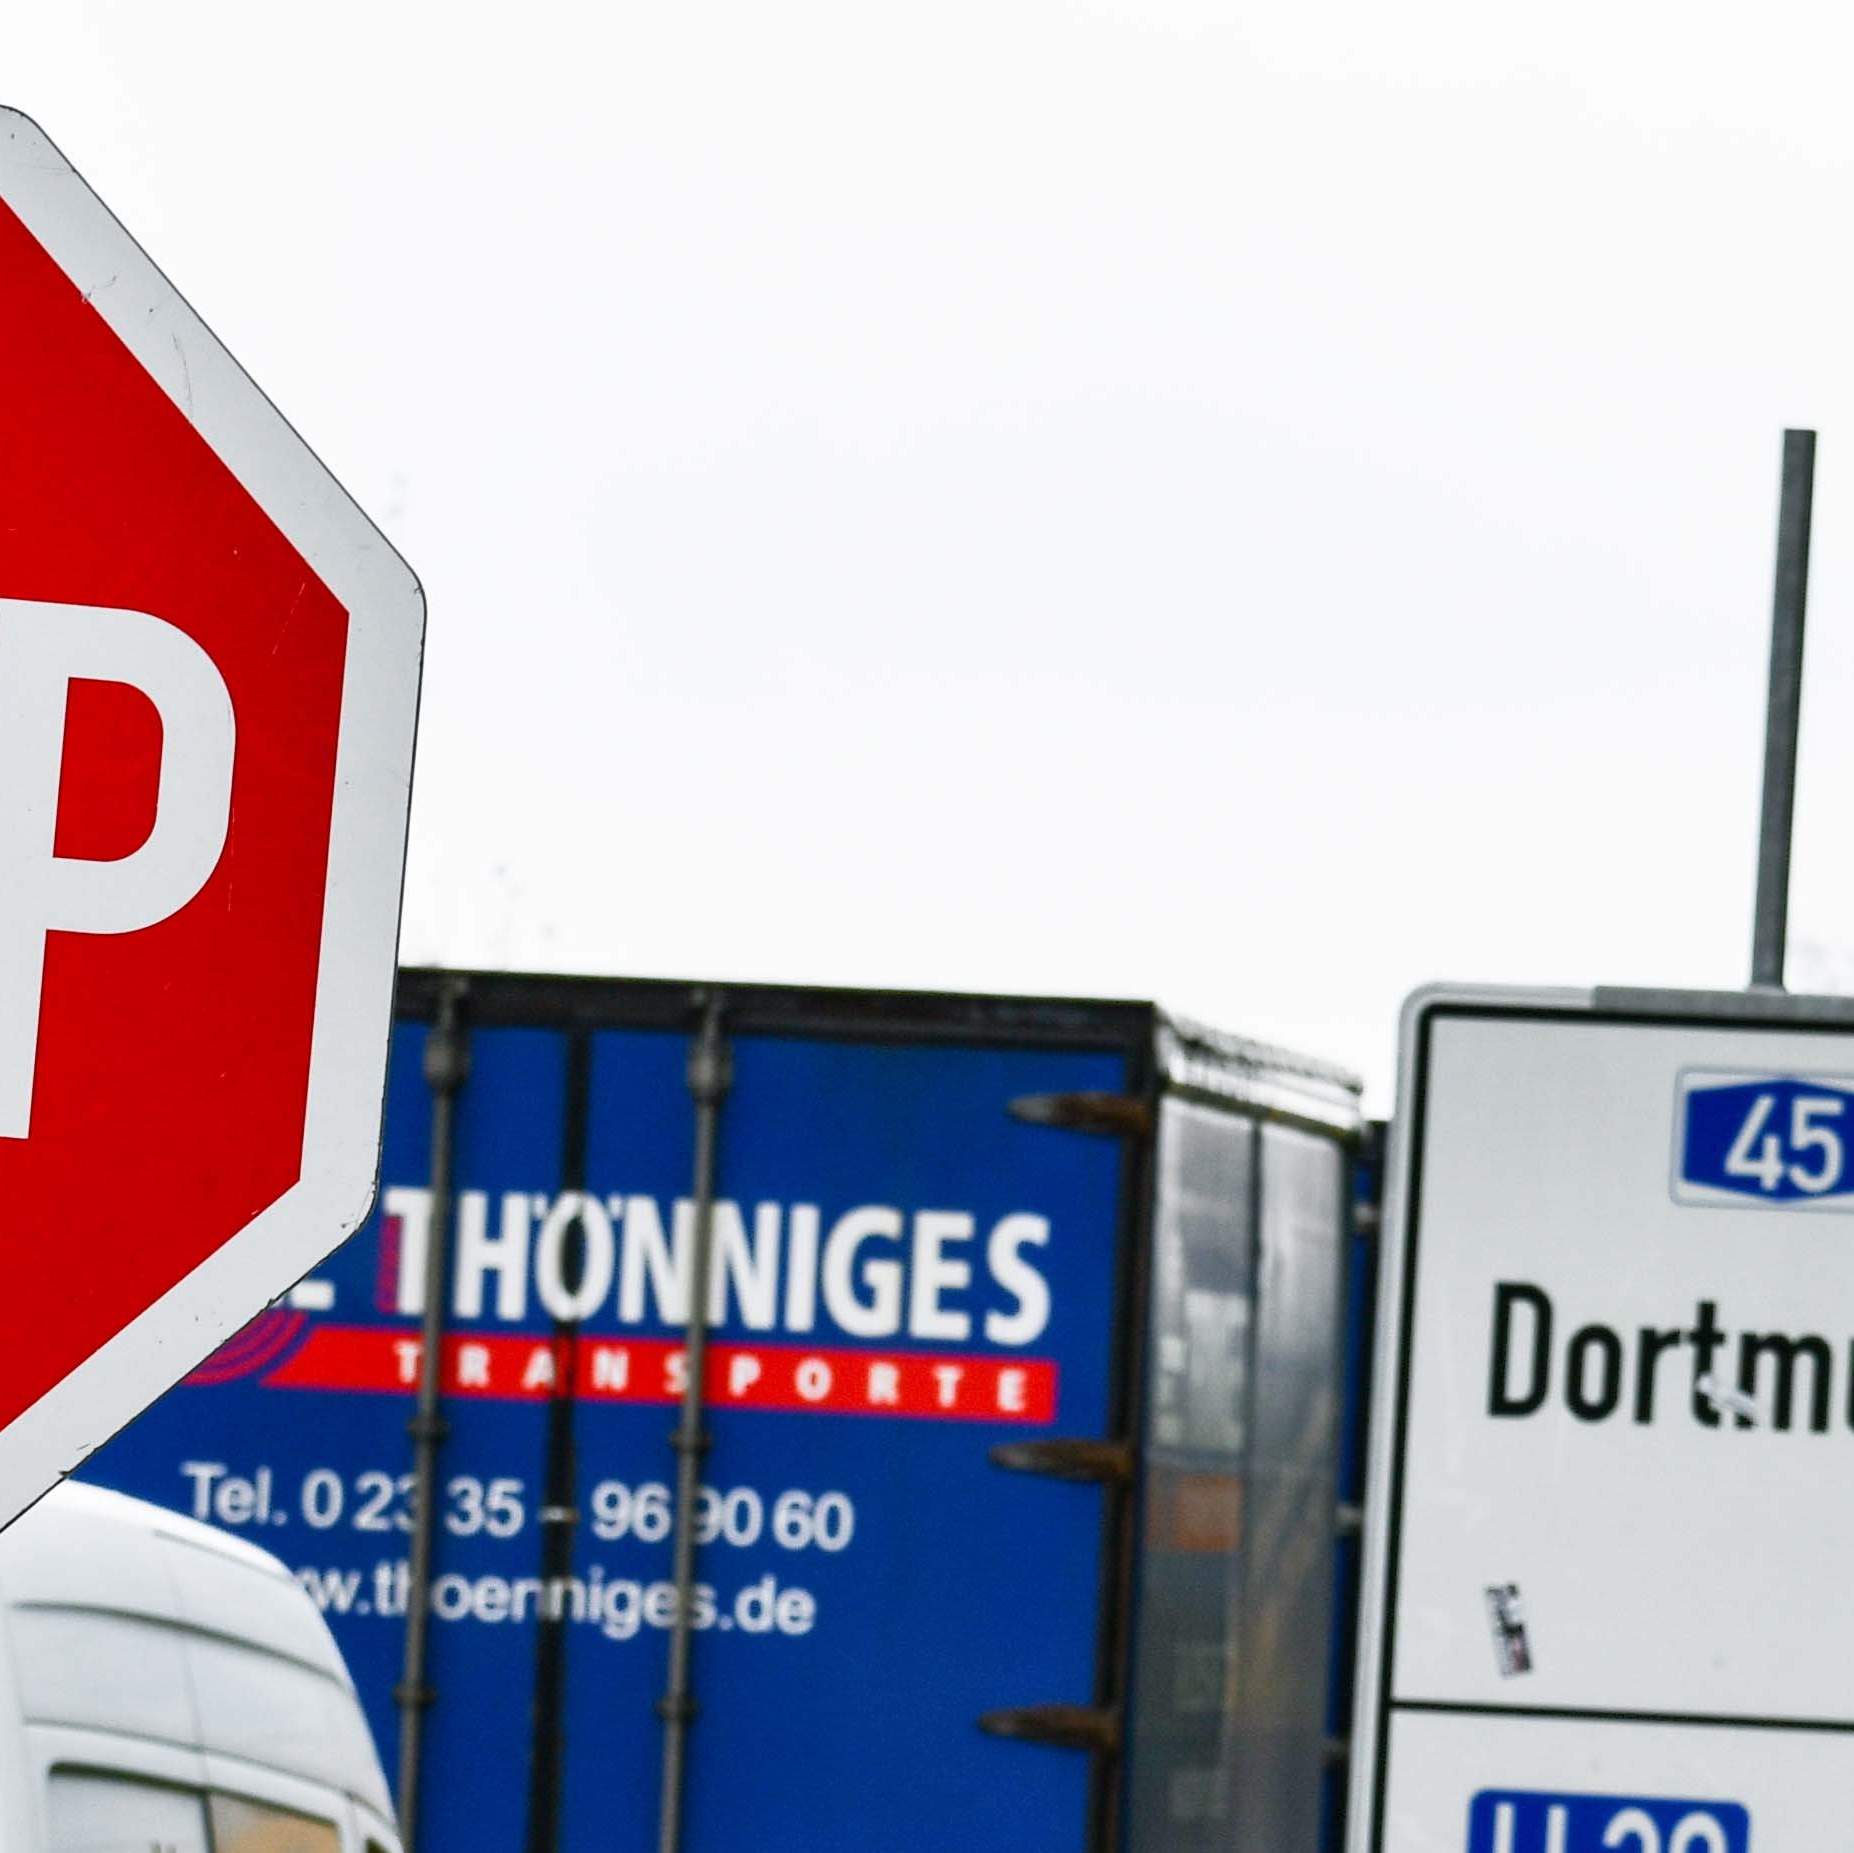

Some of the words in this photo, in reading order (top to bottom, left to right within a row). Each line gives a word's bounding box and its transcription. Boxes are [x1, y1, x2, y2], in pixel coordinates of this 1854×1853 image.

[1725, 1096, 1846, 1192] 45
[384, 1186, 1052, 1344] THÖNNIGES
[394, 1338, 1033, 1414] TRANSPORTE
[180, 1459, 289, 1526] Tel.
